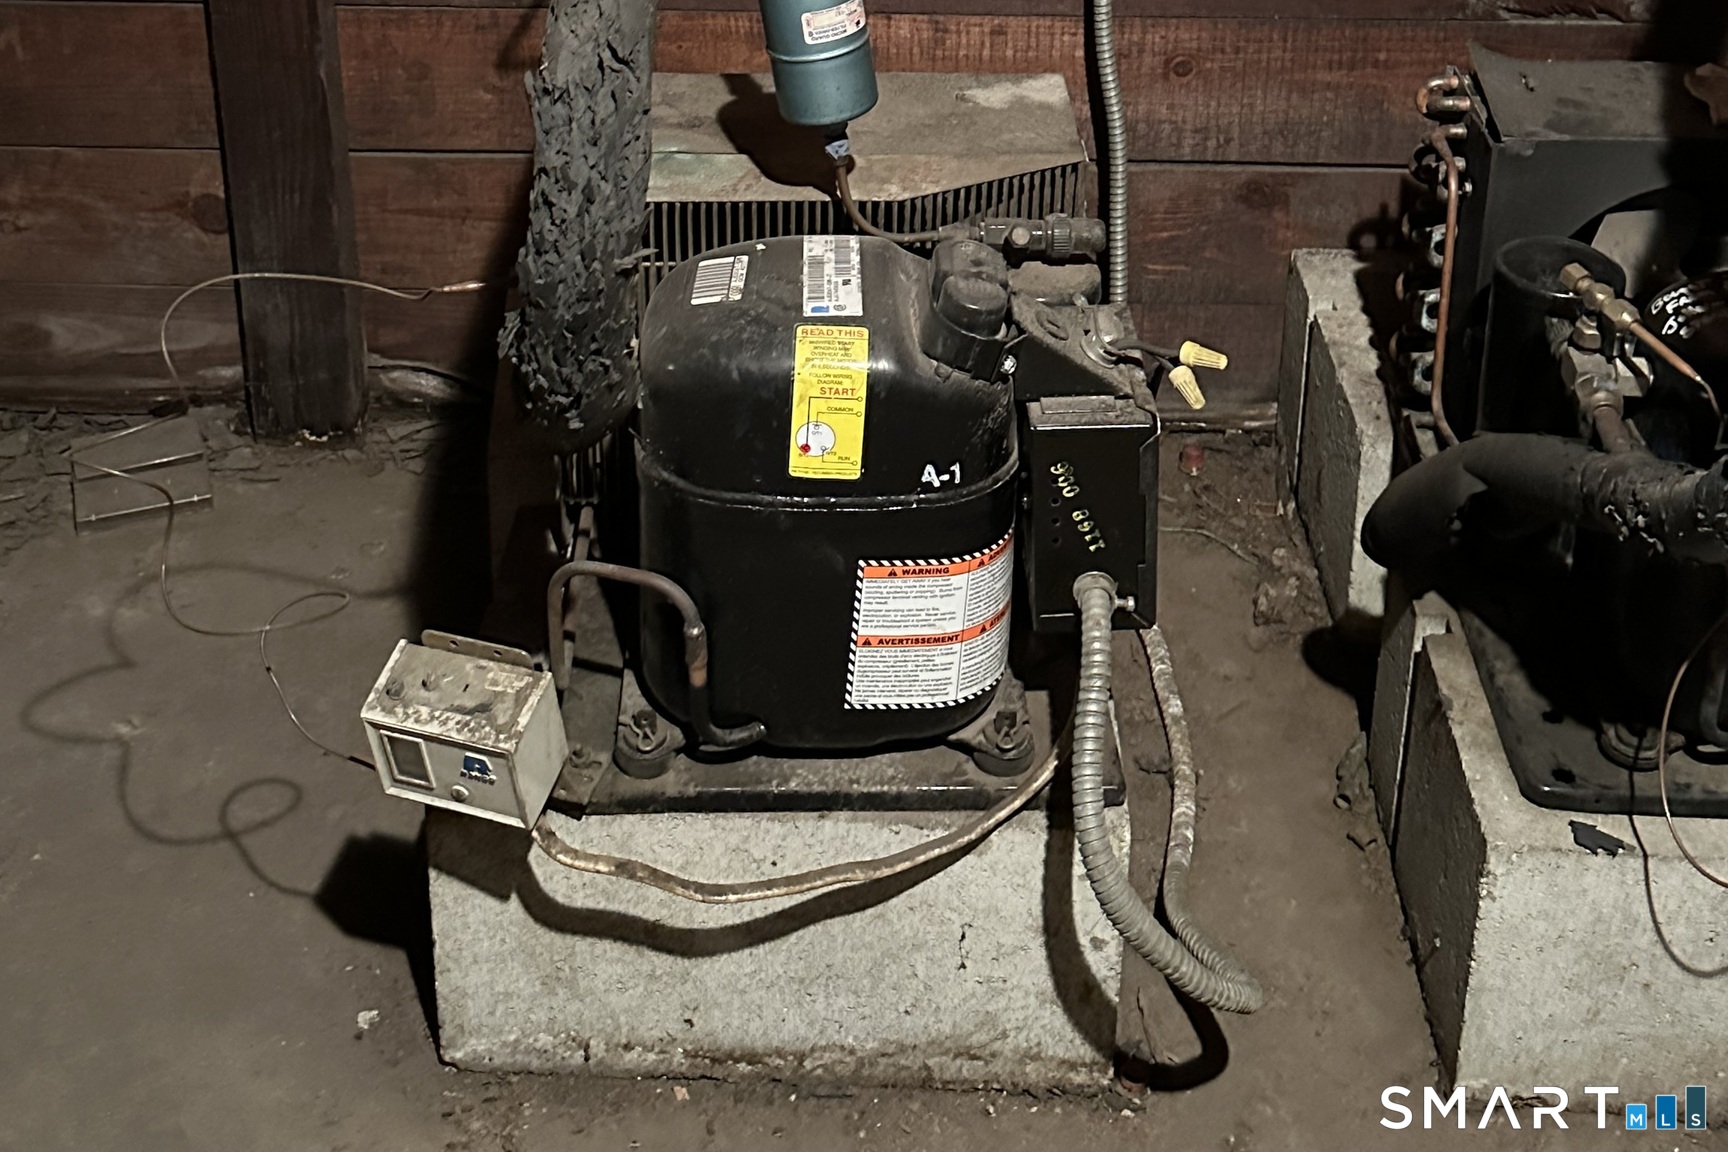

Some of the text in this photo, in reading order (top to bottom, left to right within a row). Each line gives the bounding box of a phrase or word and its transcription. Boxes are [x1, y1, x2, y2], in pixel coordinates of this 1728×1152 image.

[801, 328, 864, 337] READ THIS
[820, 387, 856, 396] START
[921, 461, 961, 488] A-1
[902, 567, 950, 575] WARNING
[877, 634, 961, 646] AVERTISSEMENT
